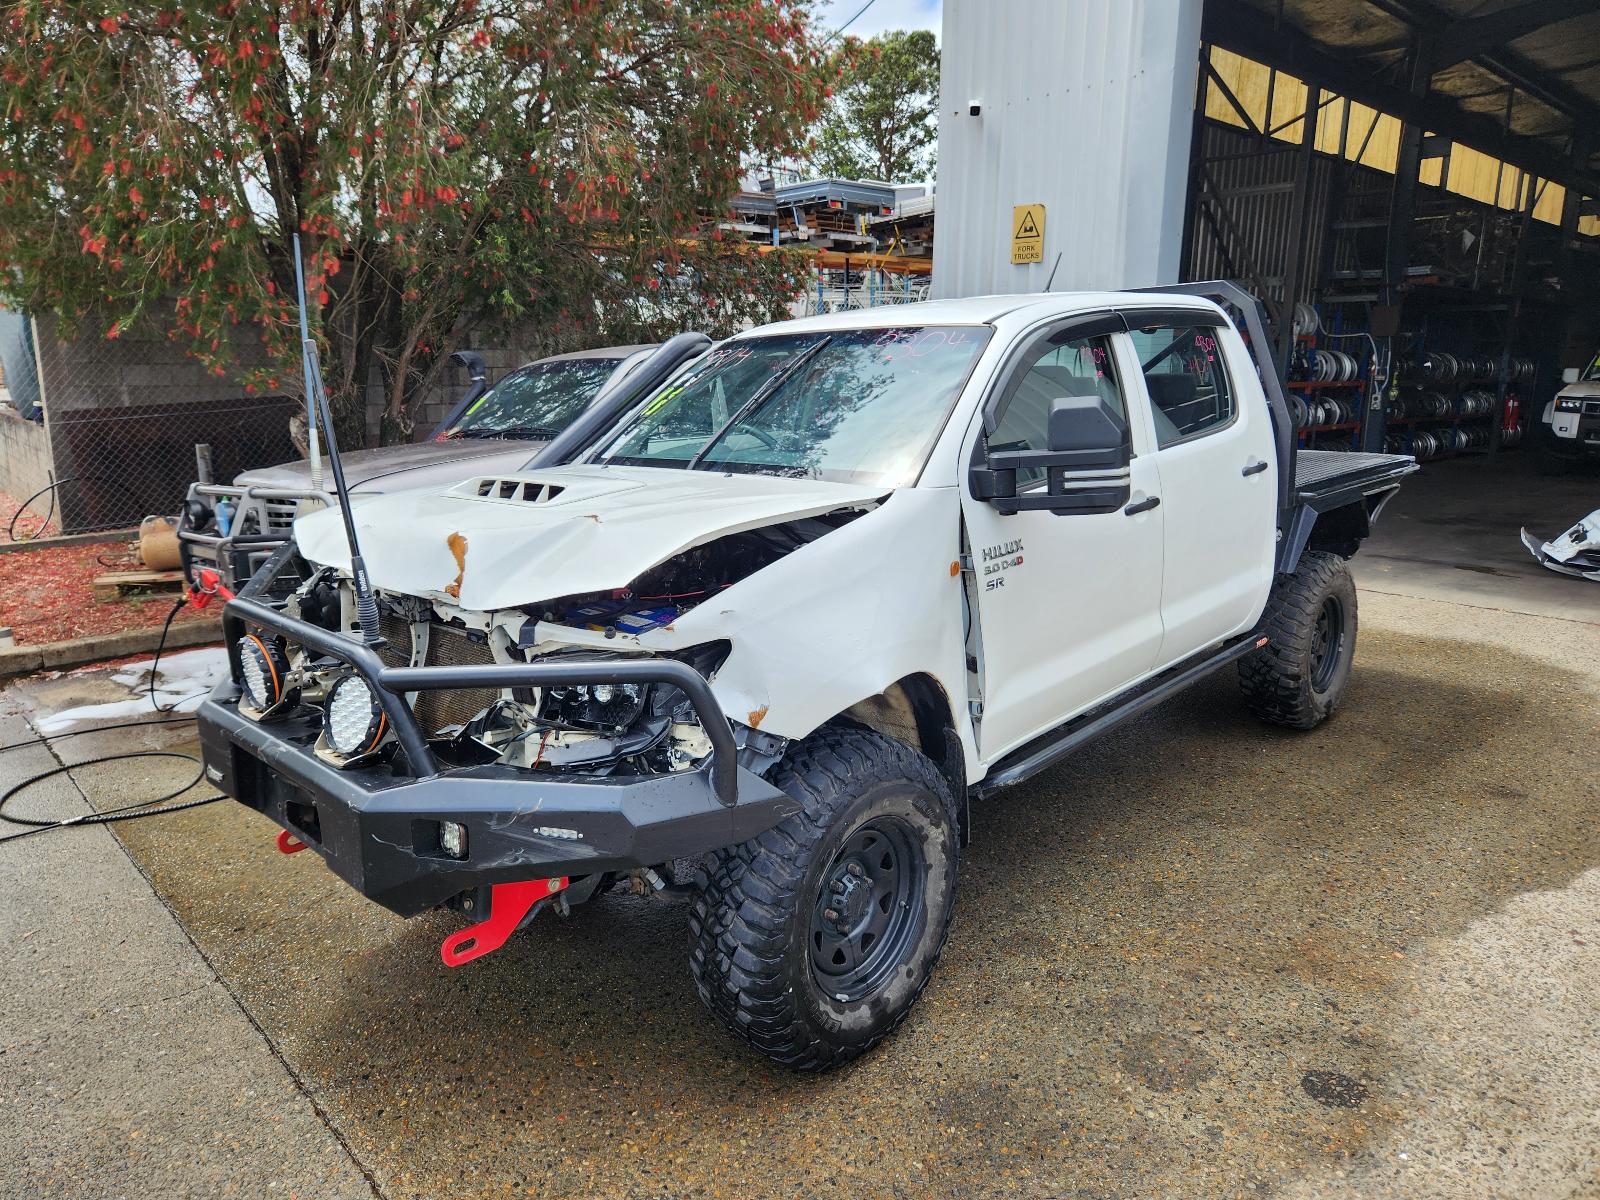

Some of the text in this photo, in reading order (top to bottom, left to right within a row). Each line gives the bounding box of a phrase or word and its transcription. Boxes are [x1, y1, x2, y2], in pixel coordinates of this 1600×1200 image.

[1014, 252, 1040, 260] TRUCKS
[982, 537, 1024, 562] HILUX
[985, 577, 1005, 592] SR
